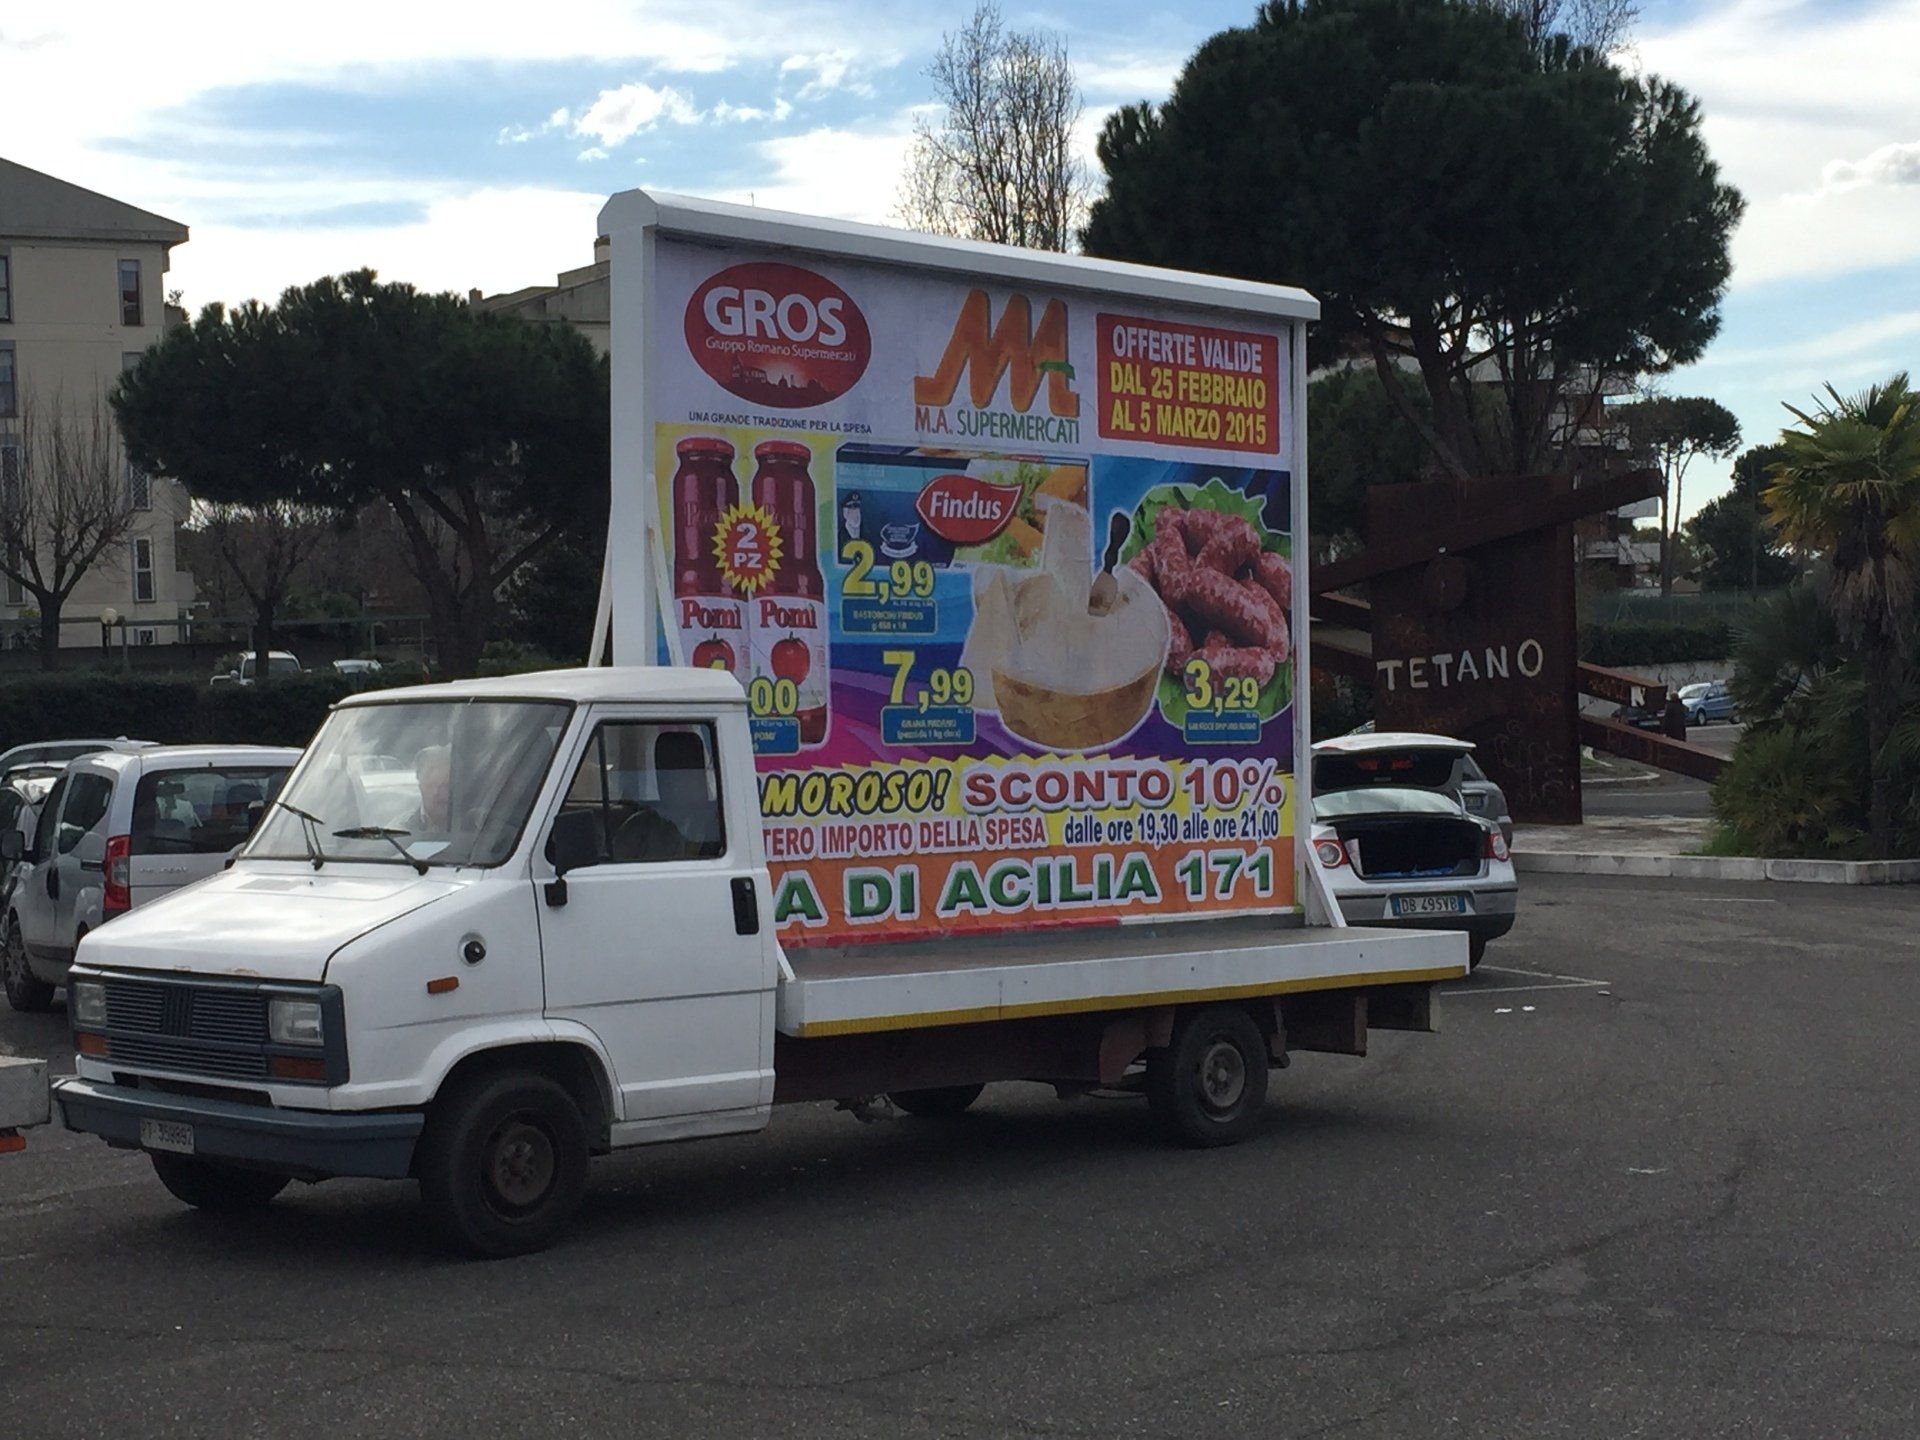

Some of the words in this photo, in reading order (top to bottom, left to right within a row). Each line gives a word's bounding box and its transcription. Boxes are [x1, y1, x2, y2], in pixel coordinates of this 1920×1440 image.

[703, 286, 847, 347] GROS
[705, 336, 746, 354] Gruppo
[747, 340, 790, 356] Romano
[1112, 325, 1196, 366] OFFERTE
[1200, 336, 1263, 374] VALIDE
[1110, 361, 1147, 396] DAL
[1151, 366, 1173, 400] 25
[1178, 370, 1266, 409] FEBBRAIO
[689, 411, 710, 422] UNA
[711, 413, 750, 426] GRANDE
[752, 416, 807, 430] TRADIZIONE
[810, 420, 828, 431] PER
[830, 422, 841, 432] LA
[843, 424, 872, 434] SPESA
[914, 406, 954, 434] M.A.
[957, 409, 1081, 444] SUPERMERCATI
[1110, 399, 1135, 432] AL
[1140, 401, 1151, 433] 5
[1156, 404, 1221, 441] MARZO
[1225, 411, 1267, 445] 2015
[929, 490, 1001, 520] Findus
[736, 523, 759, 550] 2
[733, 553, 762, 568] PZ
[842, 540, 936, 604] 2,99
[882, 651, 974, 713] 7,99
[1185, 659, 1259, 716] 3,29
[1376, 639, 1544, 691] TETANO
[757, 768, 951, 818] MOROSO!
[965, 769, 1171, 807] SCONTO
[1185, 765, 1282, 806] 10%
[821, 822, 913, 854] IMPORTO
[919, 818, 980, 849] DELLA
[985, 816, 1046, 845] SPESA
[1065, 815, 1103, 844] dalle
[1107, 819, 1133, 842] ore
[1138, 812, 1178, 846] 19,30
[1183, 811, 1209, 840] alle
[1213, 817, 1237, 839] ore
[1240, 809, 1279, 842] 21,00
[775, 876, 823, 923] A
[848, 869, 915, 919] DI
[940, 857, 1158, 912] ACILIA
[1179, 853, 1271, 897] 171
